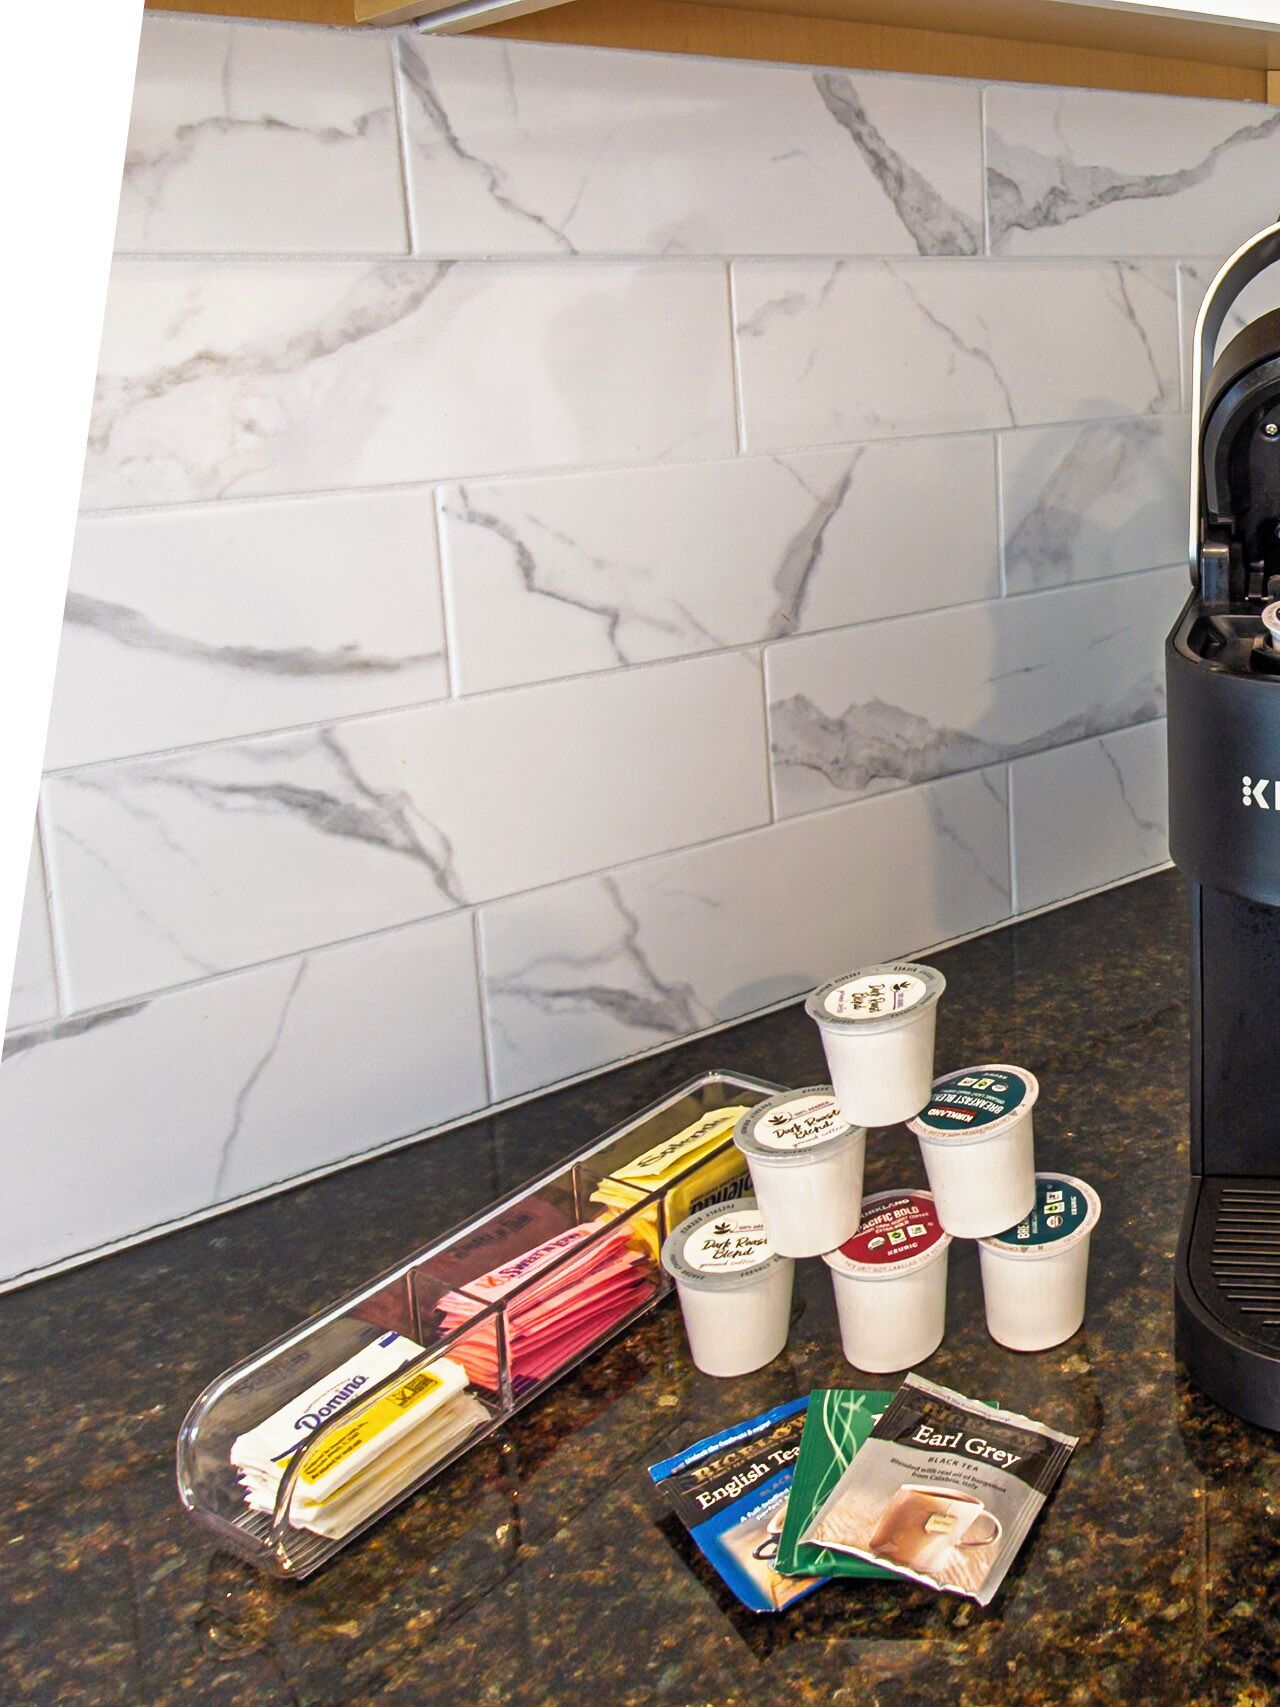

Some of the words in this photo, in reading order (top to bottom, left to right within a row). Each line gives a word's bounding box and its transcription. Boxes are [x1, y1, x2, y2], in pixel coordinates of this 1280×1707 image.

[951, 1095, 1005, 1114] BREAKFAST
[772, 1122, 802, 1139] Dark
[804, 1109, 840, 1127] Roast
[928, 1108, 974, 1123] KIRKLAND
[793, 1120, 834, 1140] Blend
[861, 1213, 894, 1231] ACIFIC
[893, 1206, 920, 1218] BOLD
[701, 1238, 731, 1251] Dark
[712, 1247, 754, 1260] Blend
[887, 1241, 919, 1257] KEURIG
[294, 1375, 369, 1430] Domino
[912, 1424, 962, 1449] Earl
[964, 1438, 1021, 1469] Grey
[890, 1457, 921, 1472] Blended
[920, 1466, 937, 1475] with
[937, 1467, 952, 1476] real
[927, 1456, 960, 1466] BLACK
[962, 1463, 979, 1472] TEA
[695, 1462, 771, 1511] English
[961, 1480, 979, 1490] Italy
